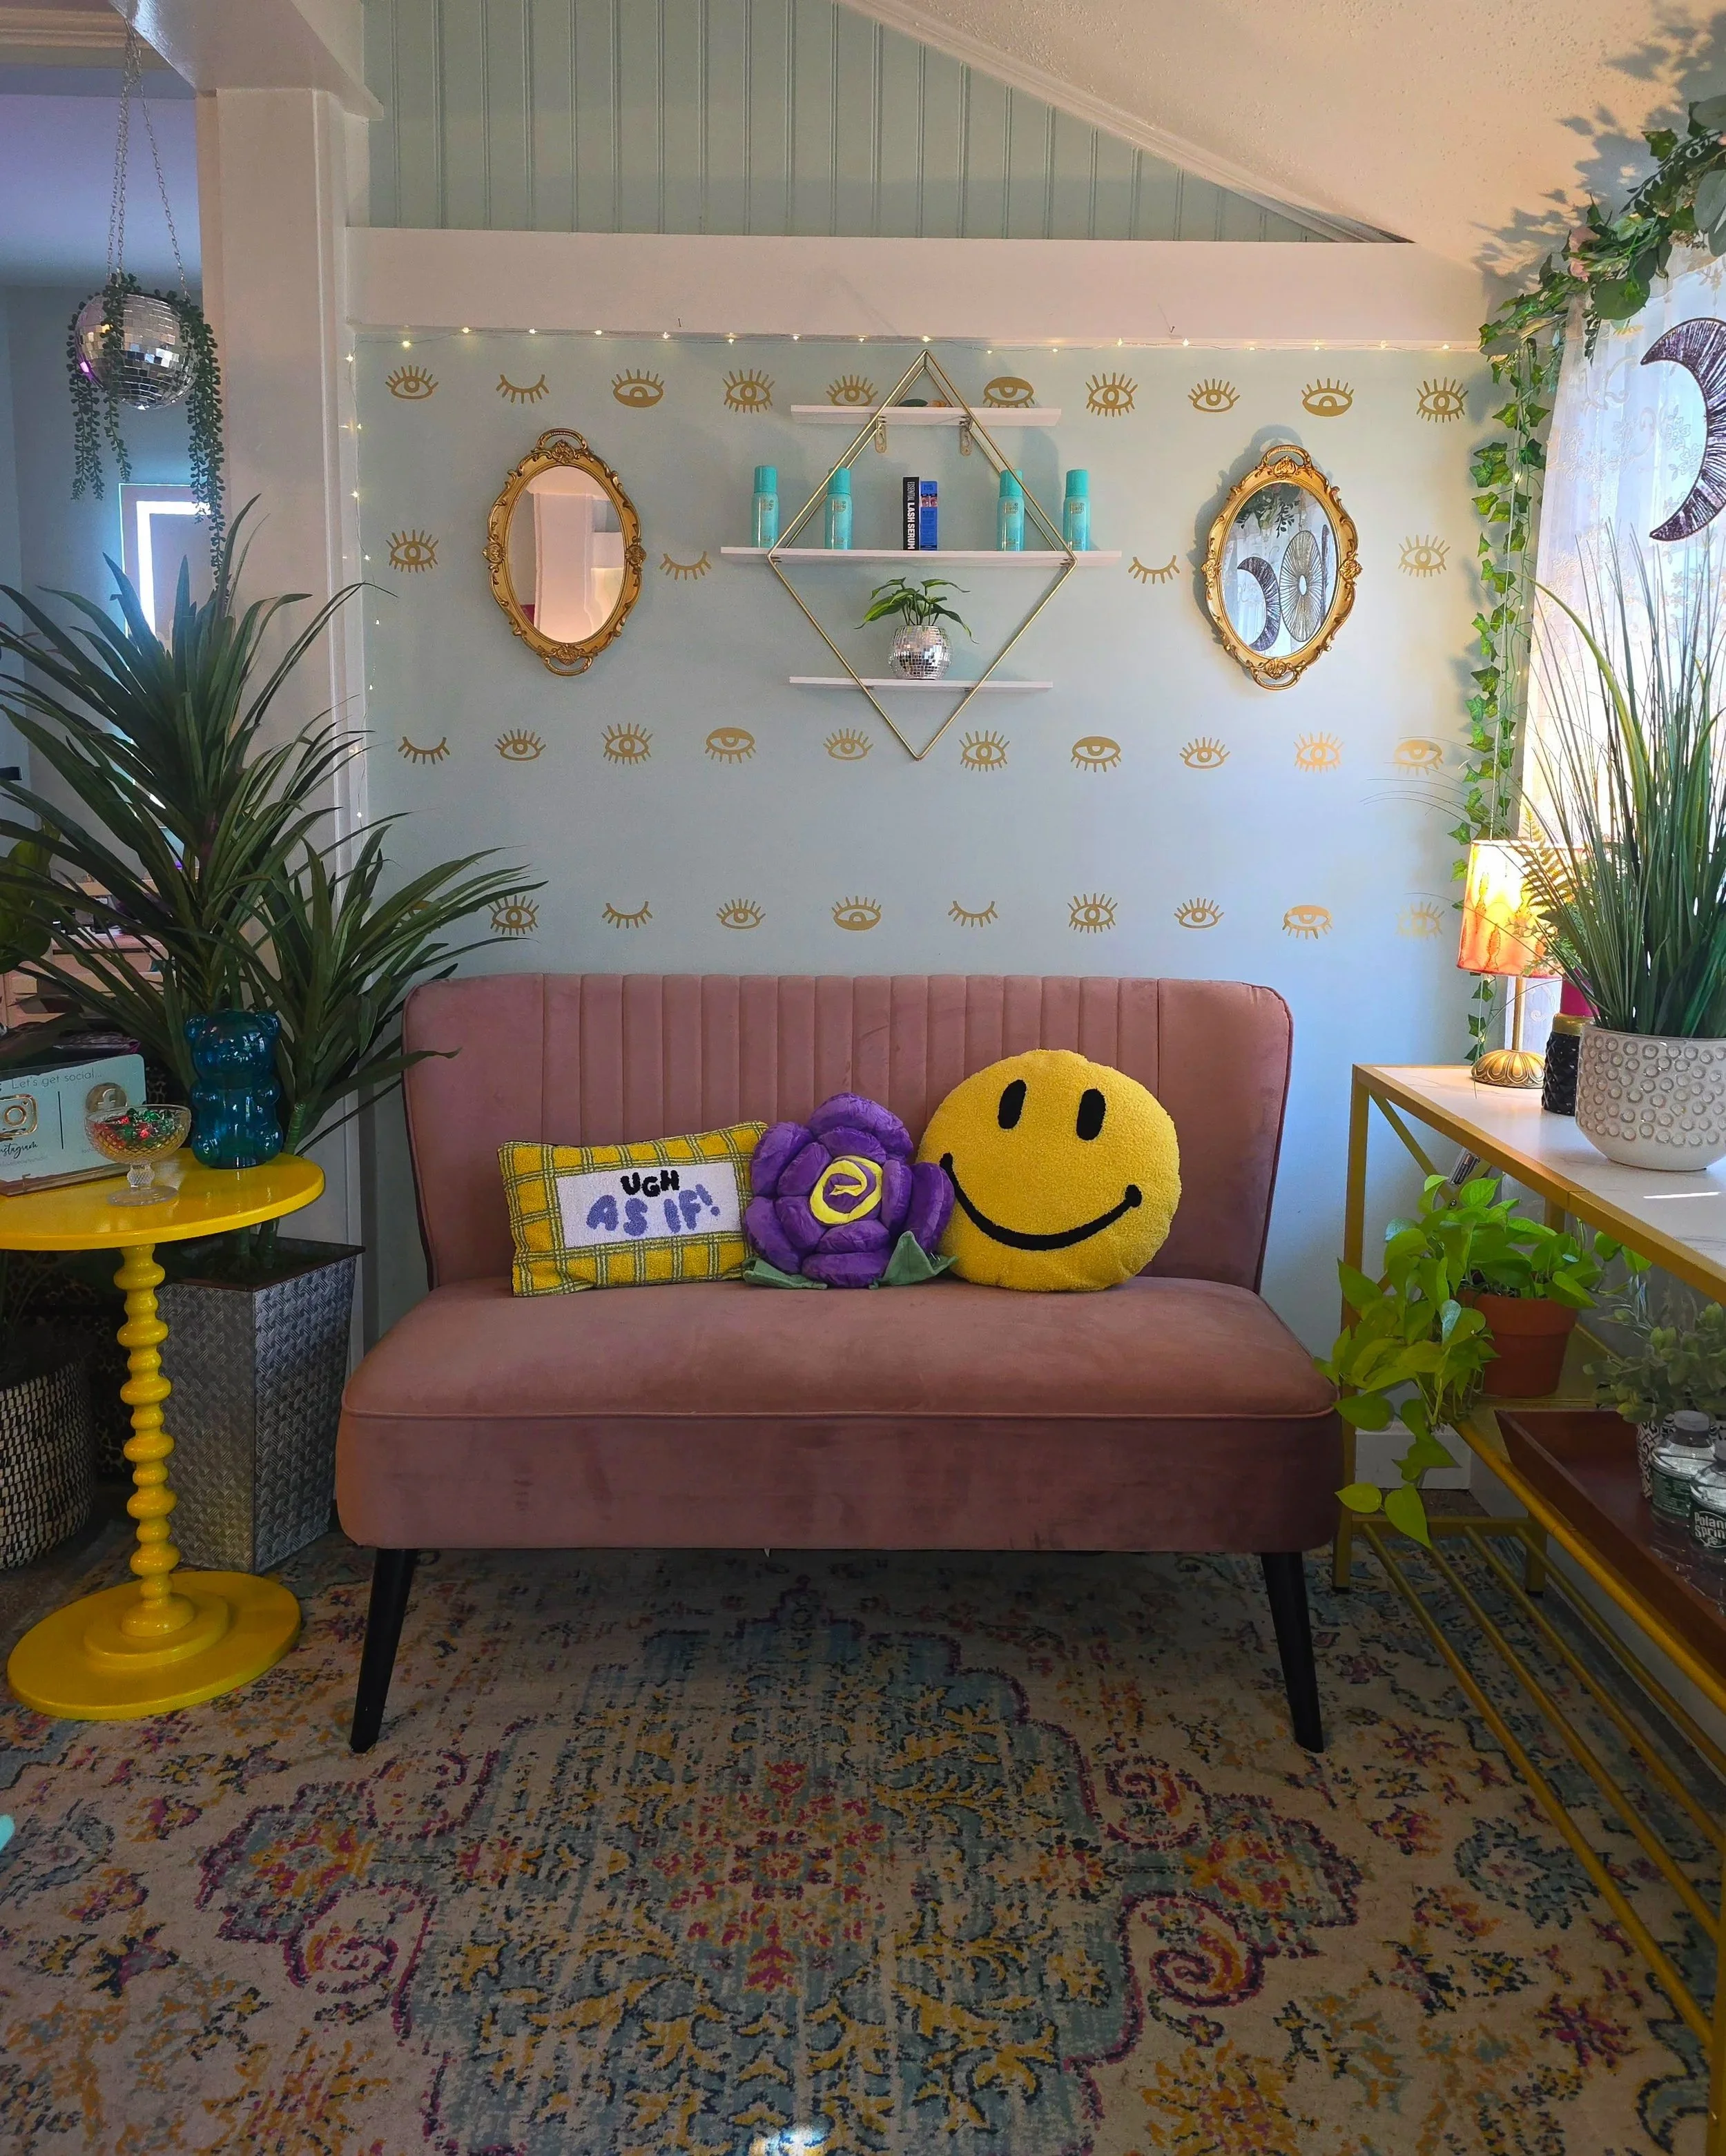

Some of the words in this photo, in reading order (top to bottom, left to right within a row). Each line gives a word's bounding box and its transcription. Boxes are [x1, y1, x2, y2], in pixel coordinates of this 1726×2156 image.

[907, 481, 915, 501] ESSENTIAL
[907, 502, 915, 523] LASH
[907, 523, 915, 550] SERUM
[11, 1076, 38, 1089] Let's
[41, 1075, 60, 1087] get
[620, 1169, 680, 1197] UGH
[586, 1194, 649, 1236] AS
[663, 1183, 721, 1234] IF!
[1694, 1512, 1726, 1530] Polan
[1694, 1524, 1726, 1540] Sprin
